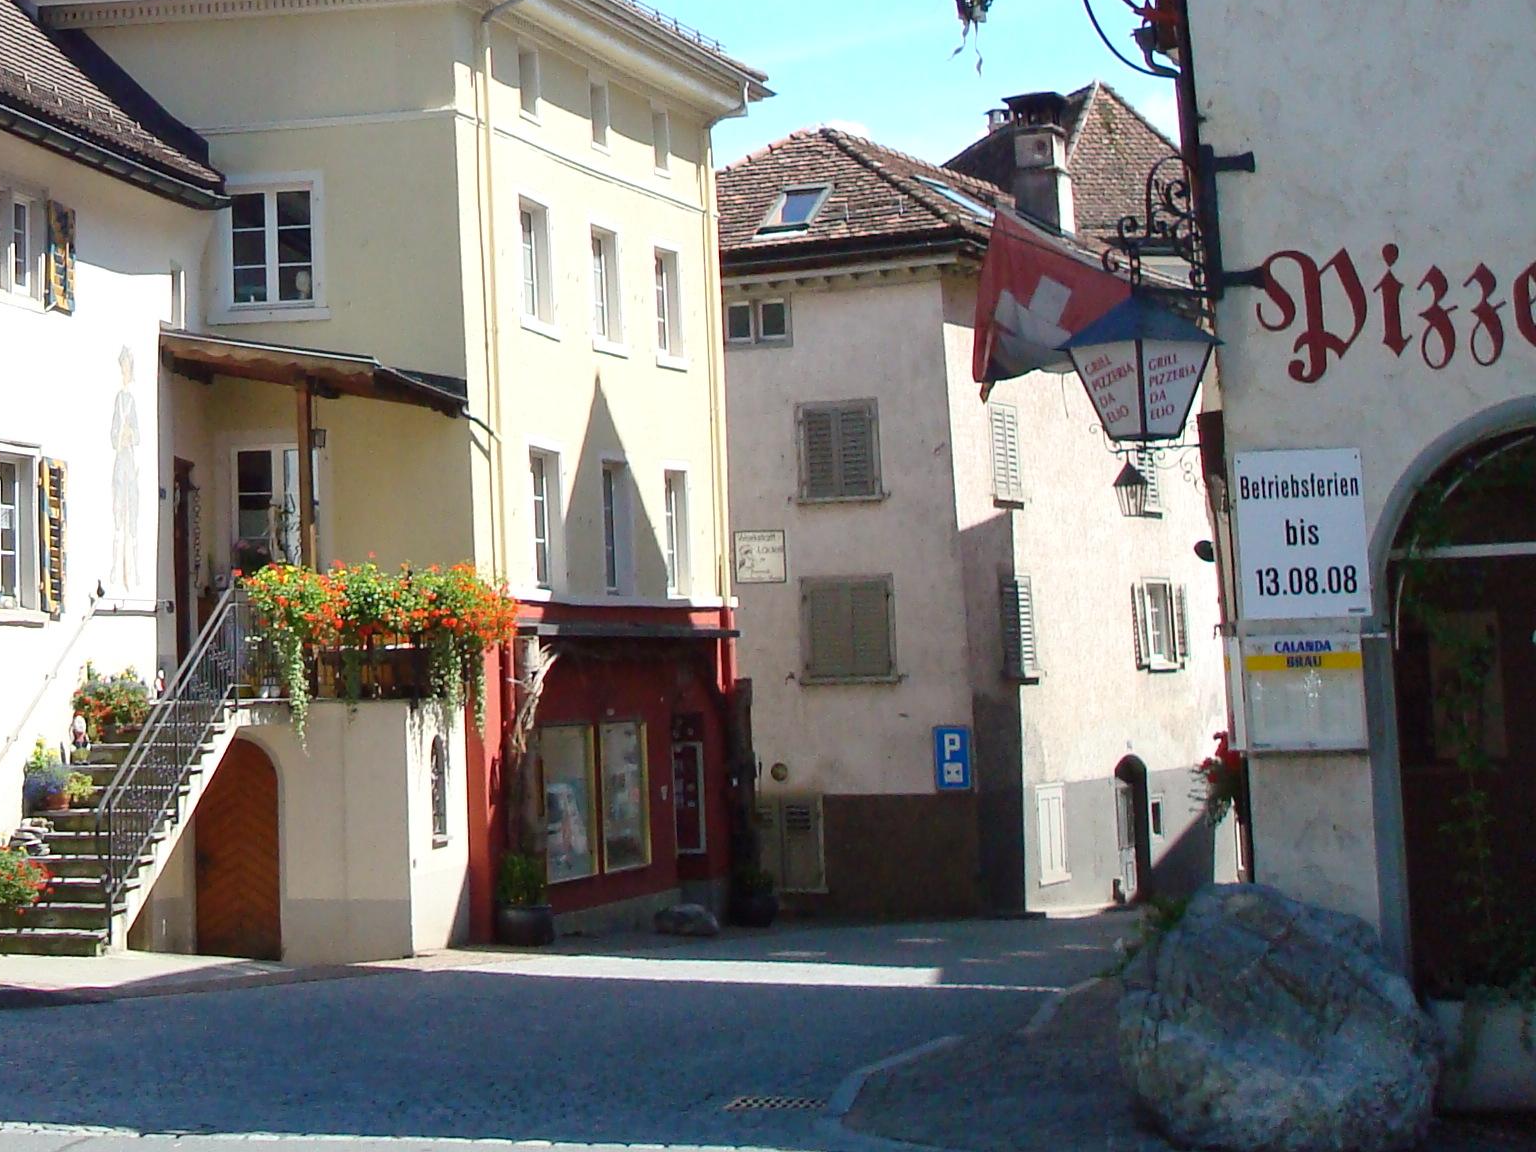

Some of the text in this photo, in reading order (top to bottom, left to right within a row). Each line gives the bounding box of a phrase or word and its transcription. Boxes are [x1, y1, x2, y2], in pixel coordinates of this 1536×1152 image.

[1084, 353, 1112, 375] GRILL
[1148, 353, 1178, 371] GRILL
[1091, 362, 1136, 392] PIZZERIA
[1149, 364, 1197, 387] PIZZERIA
[1149, 390, 1167, 404] DA
[1239, 472, 1359, 500] Betriebsferien
[1285, 518, 1320, 547] bis
[1256, 565, 1358, 596] 13.08.08
[1274, 640, 1332, 653] CALANDA
[944, 733, 961, 760] P
